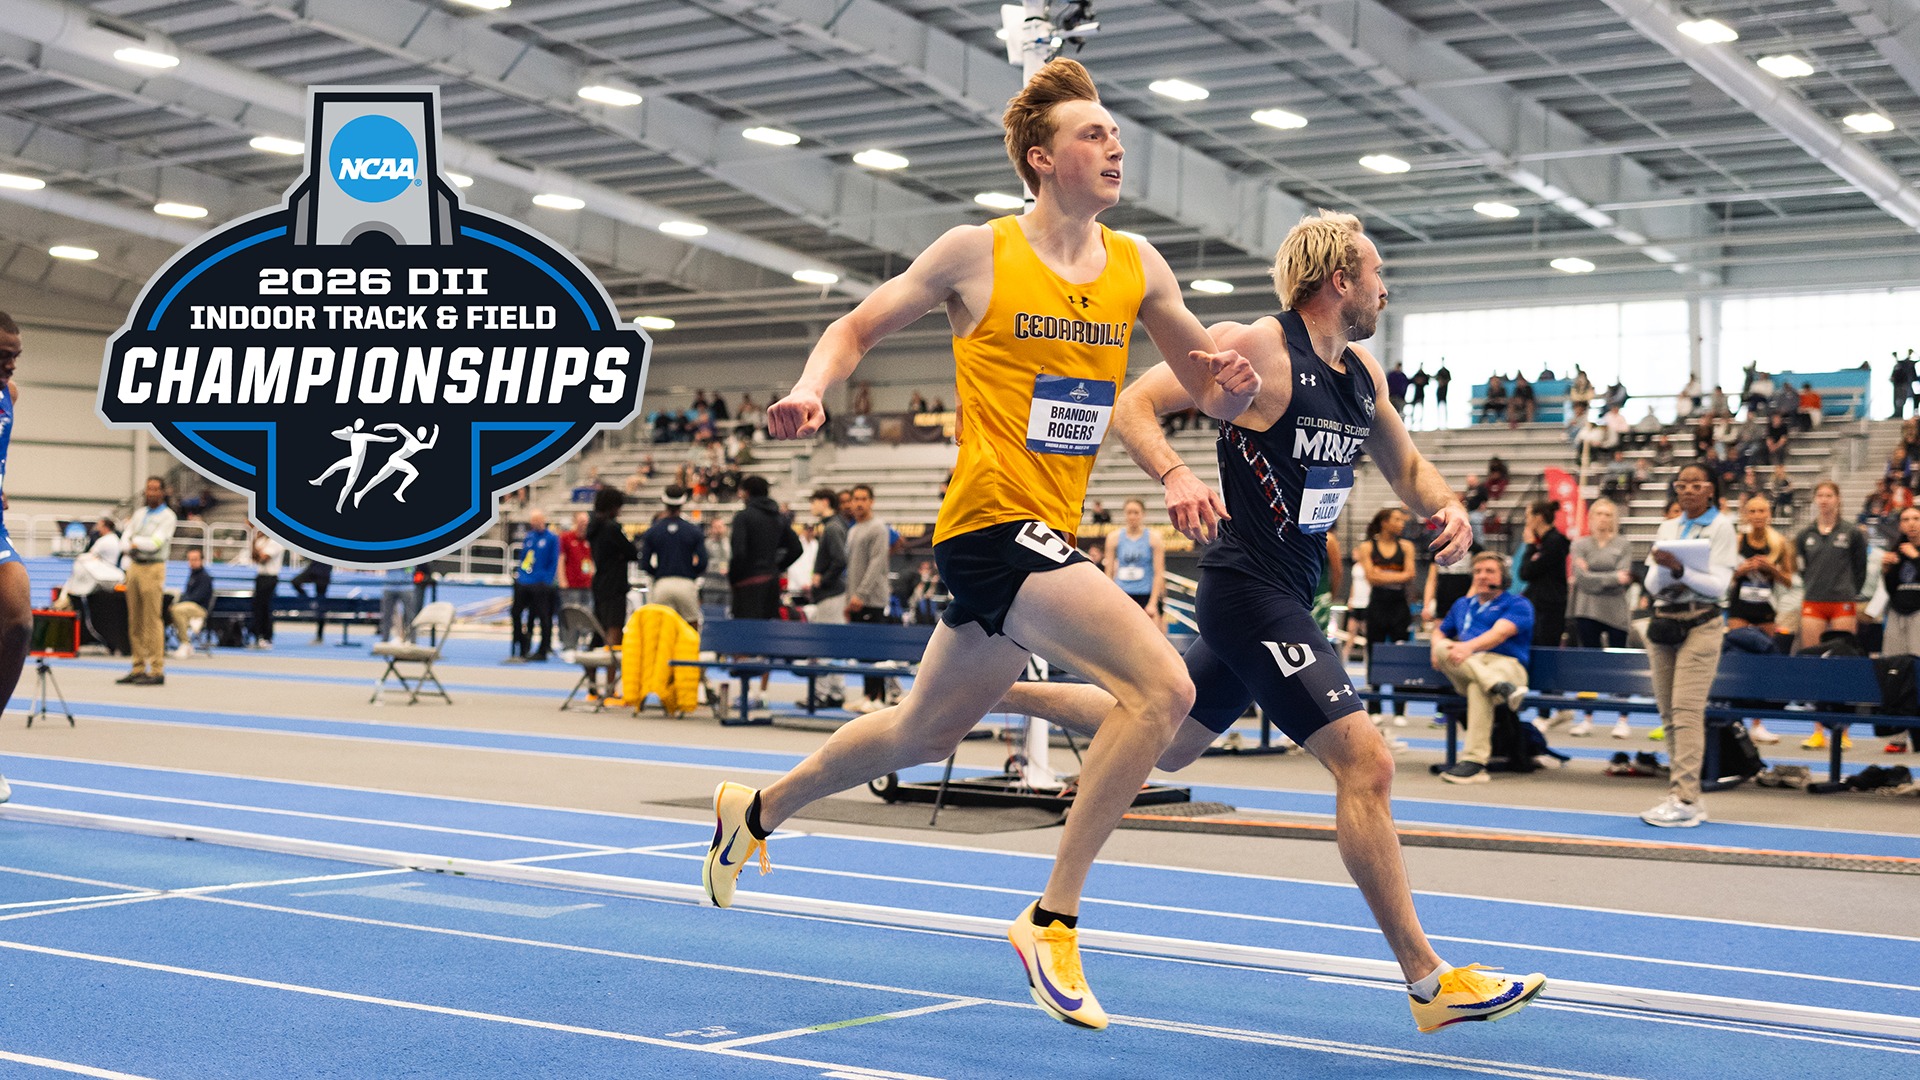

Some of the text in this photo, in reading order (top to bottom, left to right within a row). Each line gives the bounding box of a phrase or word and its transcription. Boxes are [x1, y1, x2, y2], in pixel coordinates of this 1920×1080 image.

[1014, 312, 1128, 348] CEDARVILLE
[1050, 405, 1099, 423] BRANDON
[1296, 416, 1343, 431] COLORADO
[1047, 421, 1095, 441] ROGERS
[1023, 521, 1070, 556] 5
